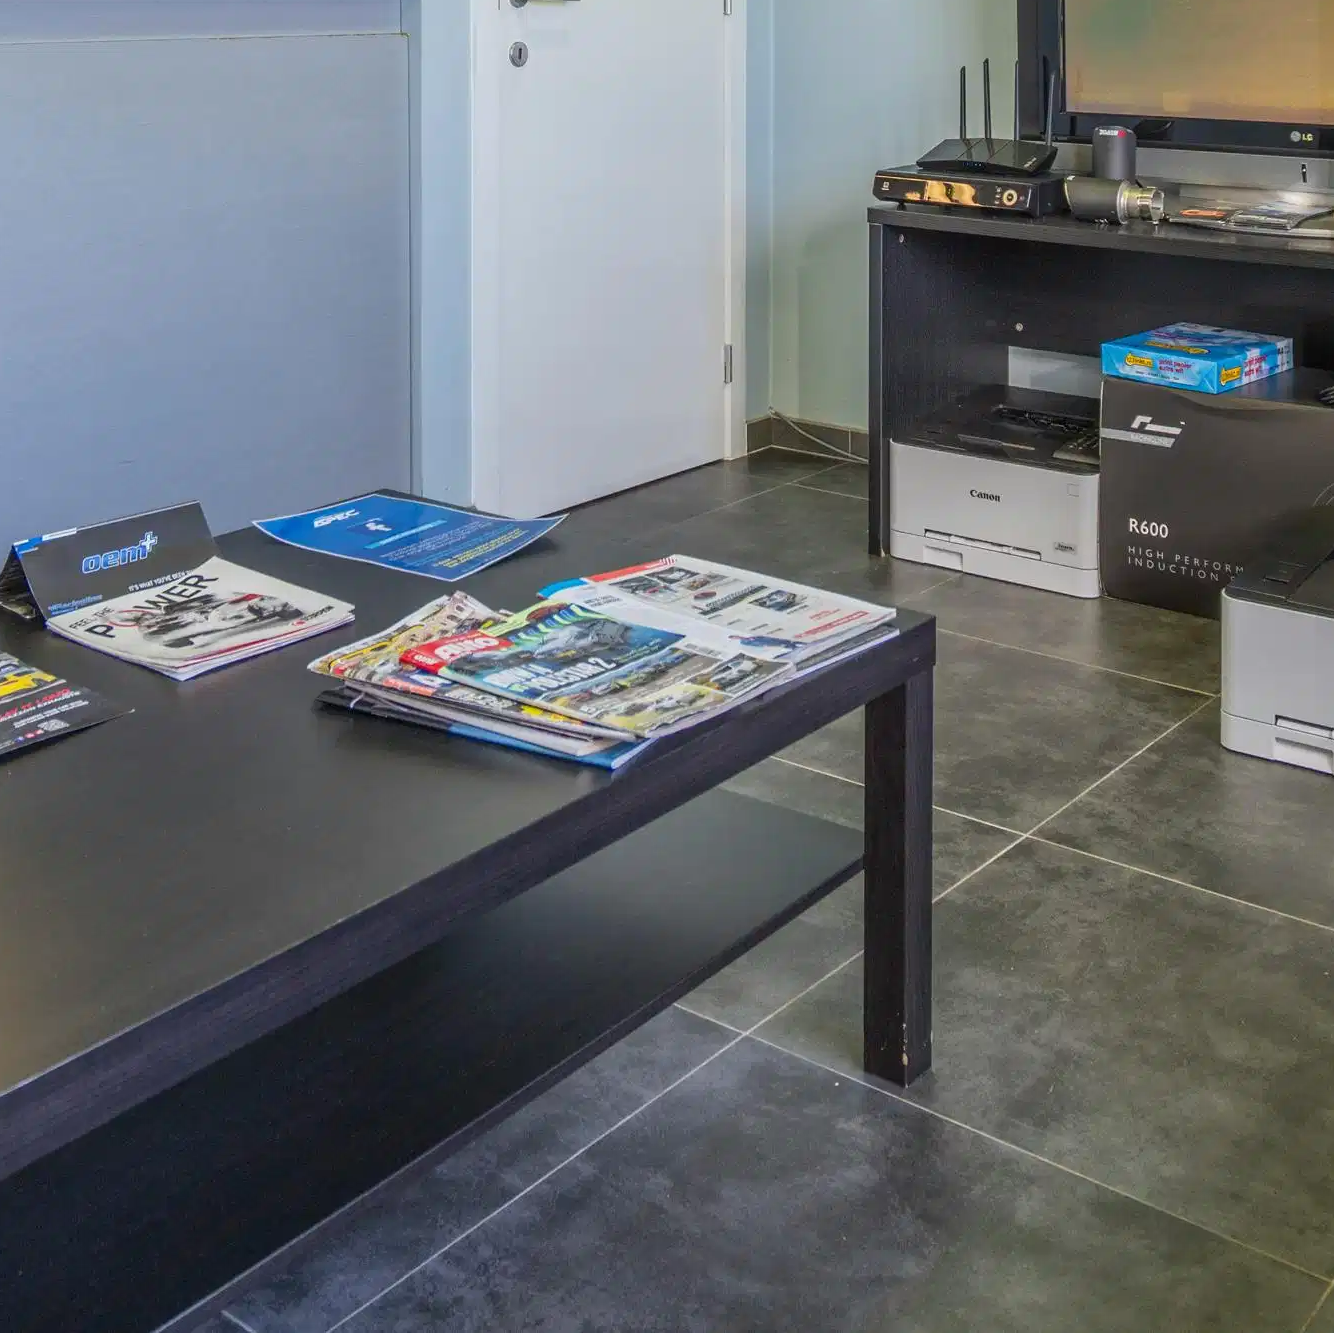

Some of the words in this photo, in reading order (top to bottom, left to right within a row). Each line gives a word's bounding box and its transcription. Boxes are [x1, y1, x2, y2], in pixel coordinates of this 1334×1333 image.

[969, 489, 1002, 503] Canon
[1129, 517, 1169, 539] R600
[1128, 545, 1165, 560] HIGH
[1174, 553, 1244, 574] PERFORM
[1128, 556, 1220, 582] INDUCTION
